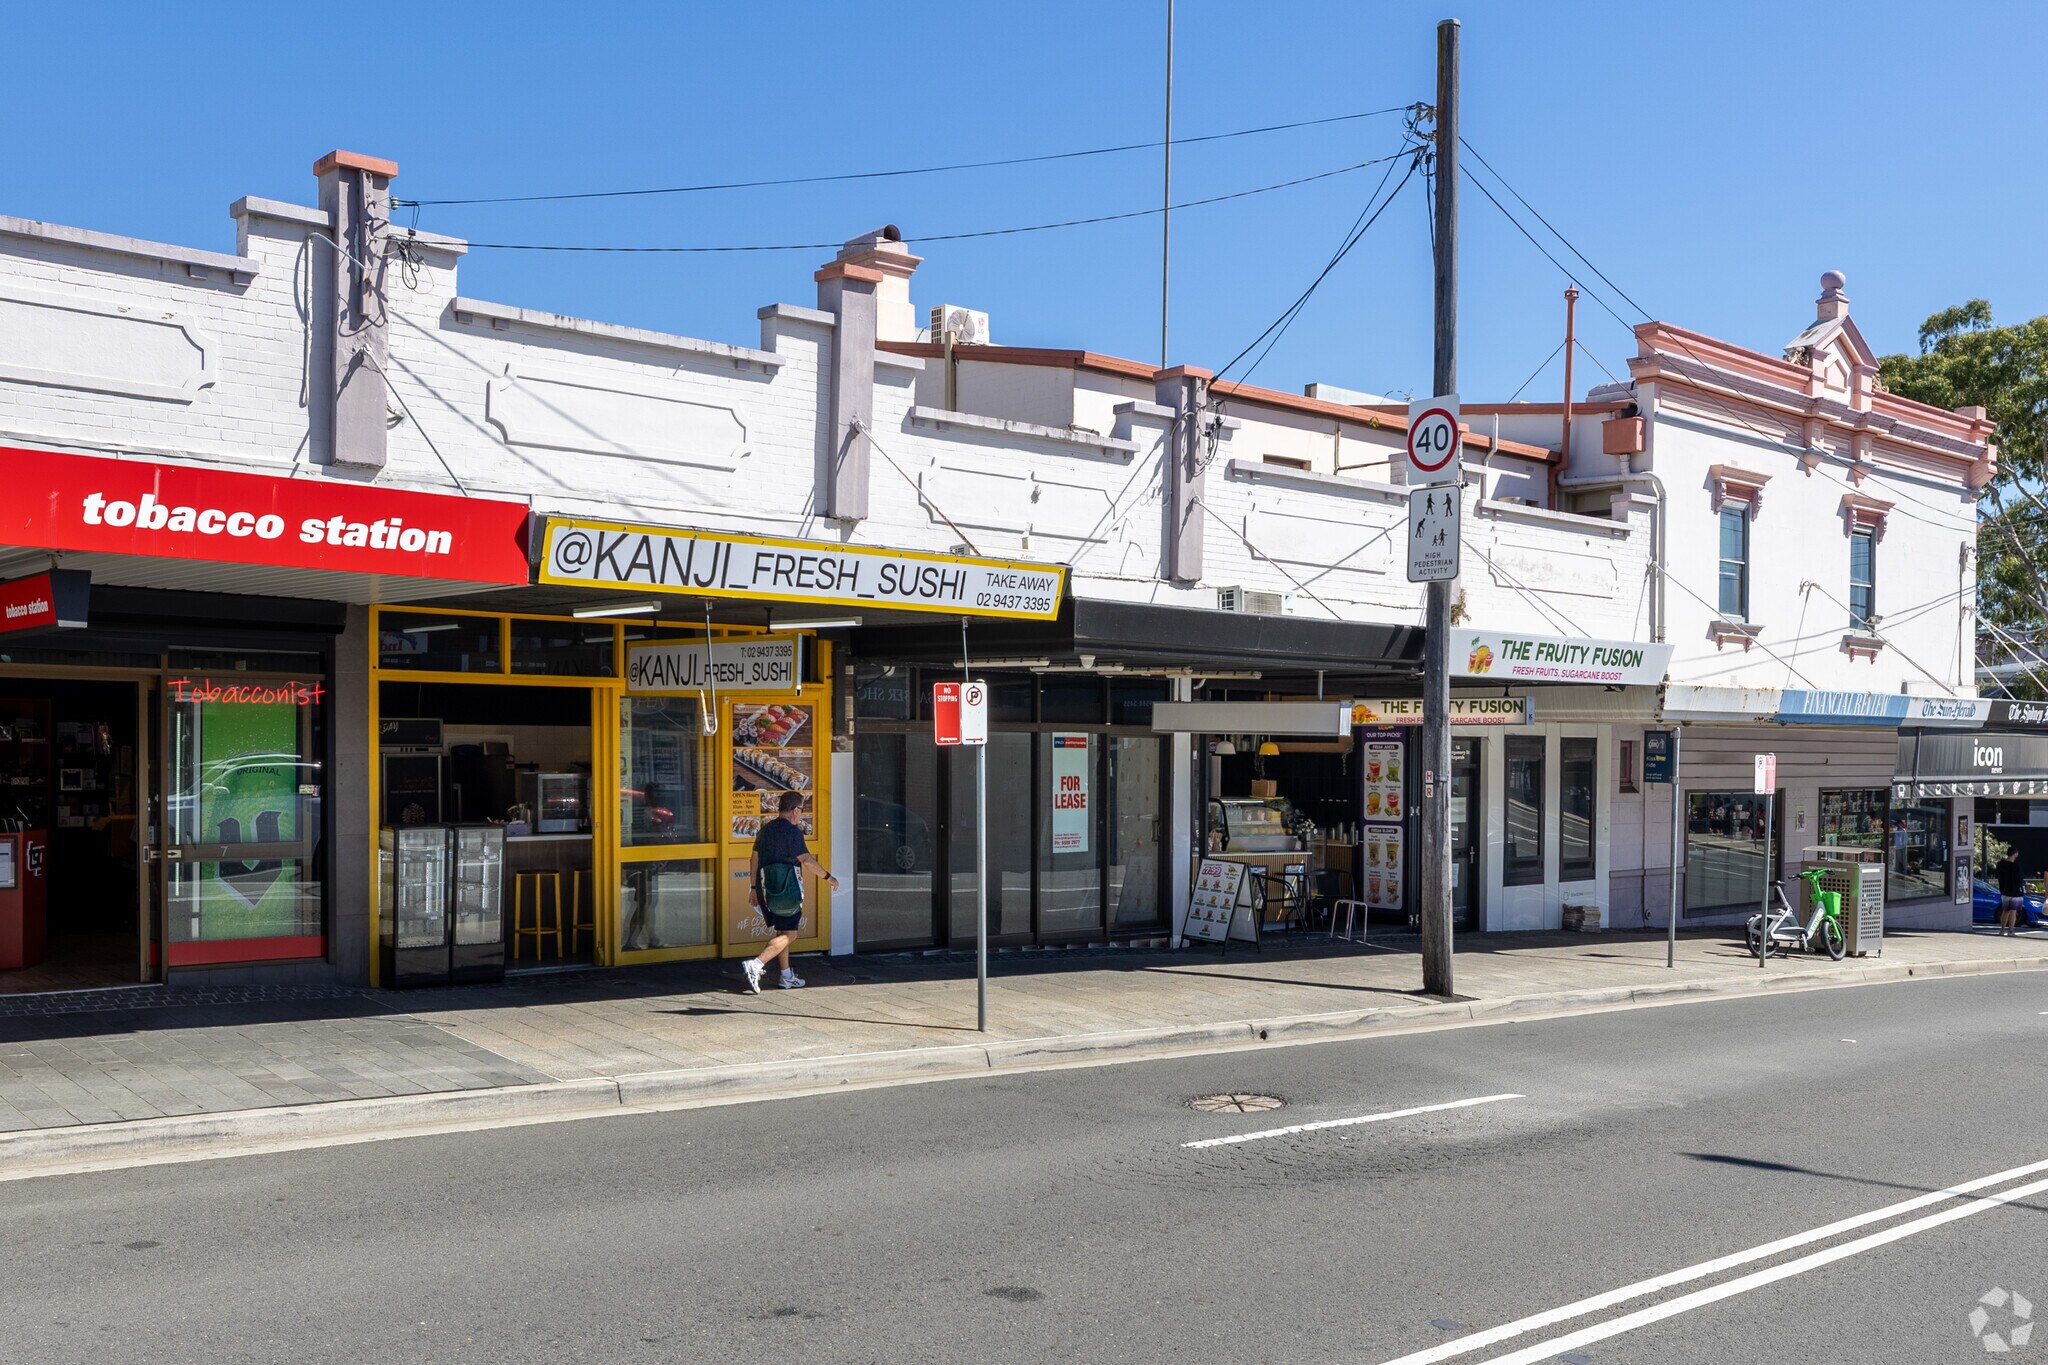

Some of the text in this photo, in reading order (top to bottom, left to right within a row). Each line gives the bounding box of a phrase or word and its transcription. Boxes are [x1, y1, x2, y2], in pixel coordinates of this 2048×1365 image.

[1416, 424, 1449, 452] 40
[82, 492, 453, 554] tobacco station
[1414, 559, 1453, 568] PEDESTRIAN
[1418, 567, 1449, 576] ACTIVITY
[986, 573, 1054, 592] TAKE AWAY
[6, 598, 49, 619] tobacco station
[976, 593, 1051, 612] 02 9437 3395
[741, 646, 792, 658] T: 02 9437 3395
[1501, 639, 1643, 667] THE FRUITY FUSION
[1512, 666, 1622, 681] FRESH FRUITS, SUGARCANE BOOST
[167, 678, 326, 705] Tobacconist
[1381, 701, 1408, 713] THE
[1469, 700, 1524, 713] FUSION
[1803, 691, 1890, 716] FINANCIAL REVIEW
[1922, 700, 1976, 720] The Sun-Herald
[836, 735, 848, 752] 3
[1973, 739, 2003, 767] icon
[236, 766, 281, 776] ORIGINAL
[1426, 772, 1432, 780] H
[1060, 776, 1080, 791] FOR
[1426, 788, 1432, 796] R
[1055, 793, 1086, 809] LEASE
[221, 846, 228, 857] 7
